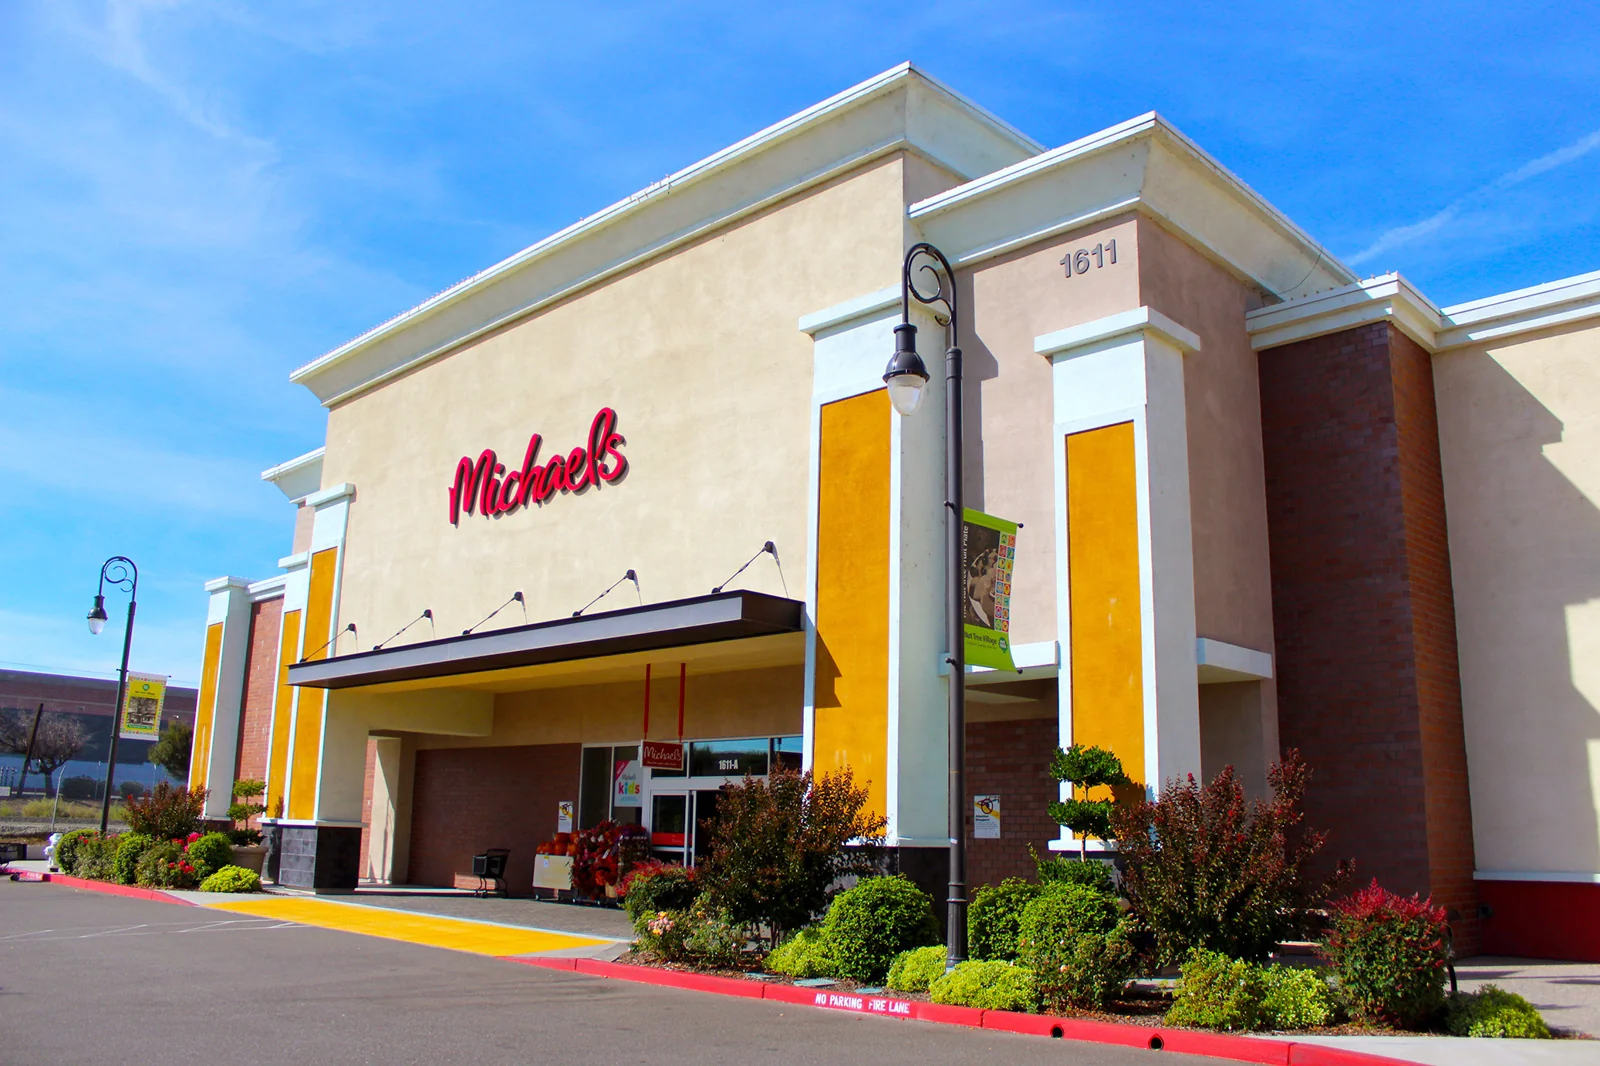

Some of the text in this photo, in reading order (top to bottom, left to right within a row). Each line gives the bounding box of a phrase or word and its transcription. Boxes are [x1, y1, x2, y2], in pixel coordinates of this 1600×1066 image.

[1059, 238, 1117, 278] 1611
[448, 406, 628, 528] Michaels
[643, 746, 682, 761] Michaels
[718, 759, 739, 770] 1611-A
[618, 781, 640, 795] kids
[815, 993, 910, 1014] NO PARKING FIRE LANE
